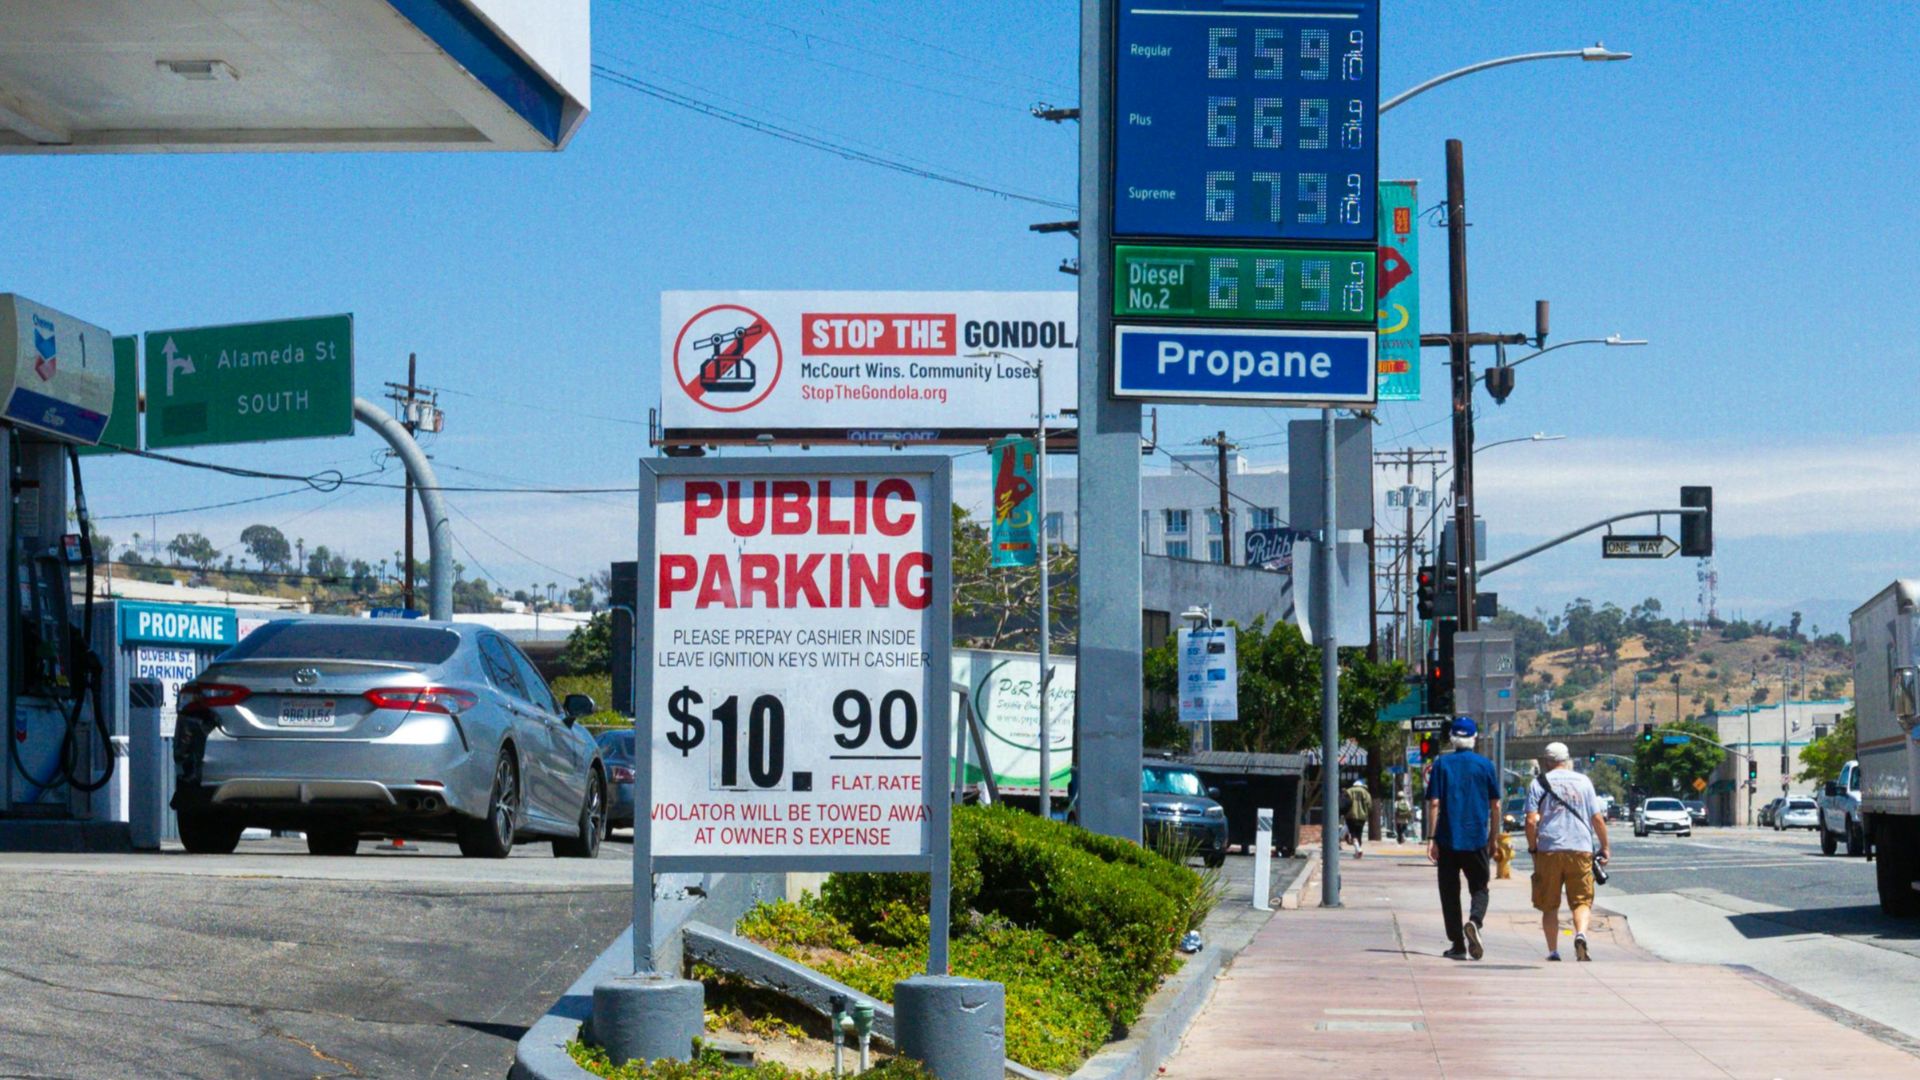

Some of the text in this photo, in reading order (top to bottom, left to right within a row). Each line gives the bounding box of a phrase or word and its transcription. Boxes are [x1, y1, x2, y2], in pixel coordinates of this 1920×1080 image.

[1131, 43, 1172, 58] Regular
[1208, 28, 1330, 80] 659
[1129, 112, 1152, 127] Plus
[1208, 96, 1329, 149] 669
[1129, 186, 1176, 201] Supreme
[1206, 170, 1328, 224] 679
[1129, 262, 1185, 286] Diesel
[1129, 287, 1170, 310] No.2
[812, 319, 1078, 348] STOP THE GONDOL
[218, 341, 337, 369] Alameda St
[1157, 340, 1332, 384] Propane
[801, 362, 860, 379] McCourt
[864, 362, 905, 379] Wins.
[909, 362, 992, 382] Community
[237, 390, 309, 415] SOUTH
[801, 384, 947, 403] StopTheGondola.org
[684, 478, 917, 537] PUBLIC
[1608, 541, 1661, 553] ONE WAY
[658, 552, 933, 610] PARKING
[139, 611, 224, 640] PROPANE
[674, 629, 916, 646] PLEASE PREPAY CASHIER INSIDE
[140, 649, 177, 662] OLVERA
[658, 651, 931, 668] LEAVE IGNITION KEYS WITH CASHIER
[140, 664, 194, 680] PARKING
[831, 776, 921, 790] FLAT RATE
[651, 803, 736, 821] VIOLATOR
[741, 804, 782, 821] WILL
[788, 804, 811, 821] BE
[817, 804, 882, 822] TOWED
[694, 827, 715, 845] AT
[721, 828, 788, 845] OWNER
[809, 828, 891, 846] EXPENSE
